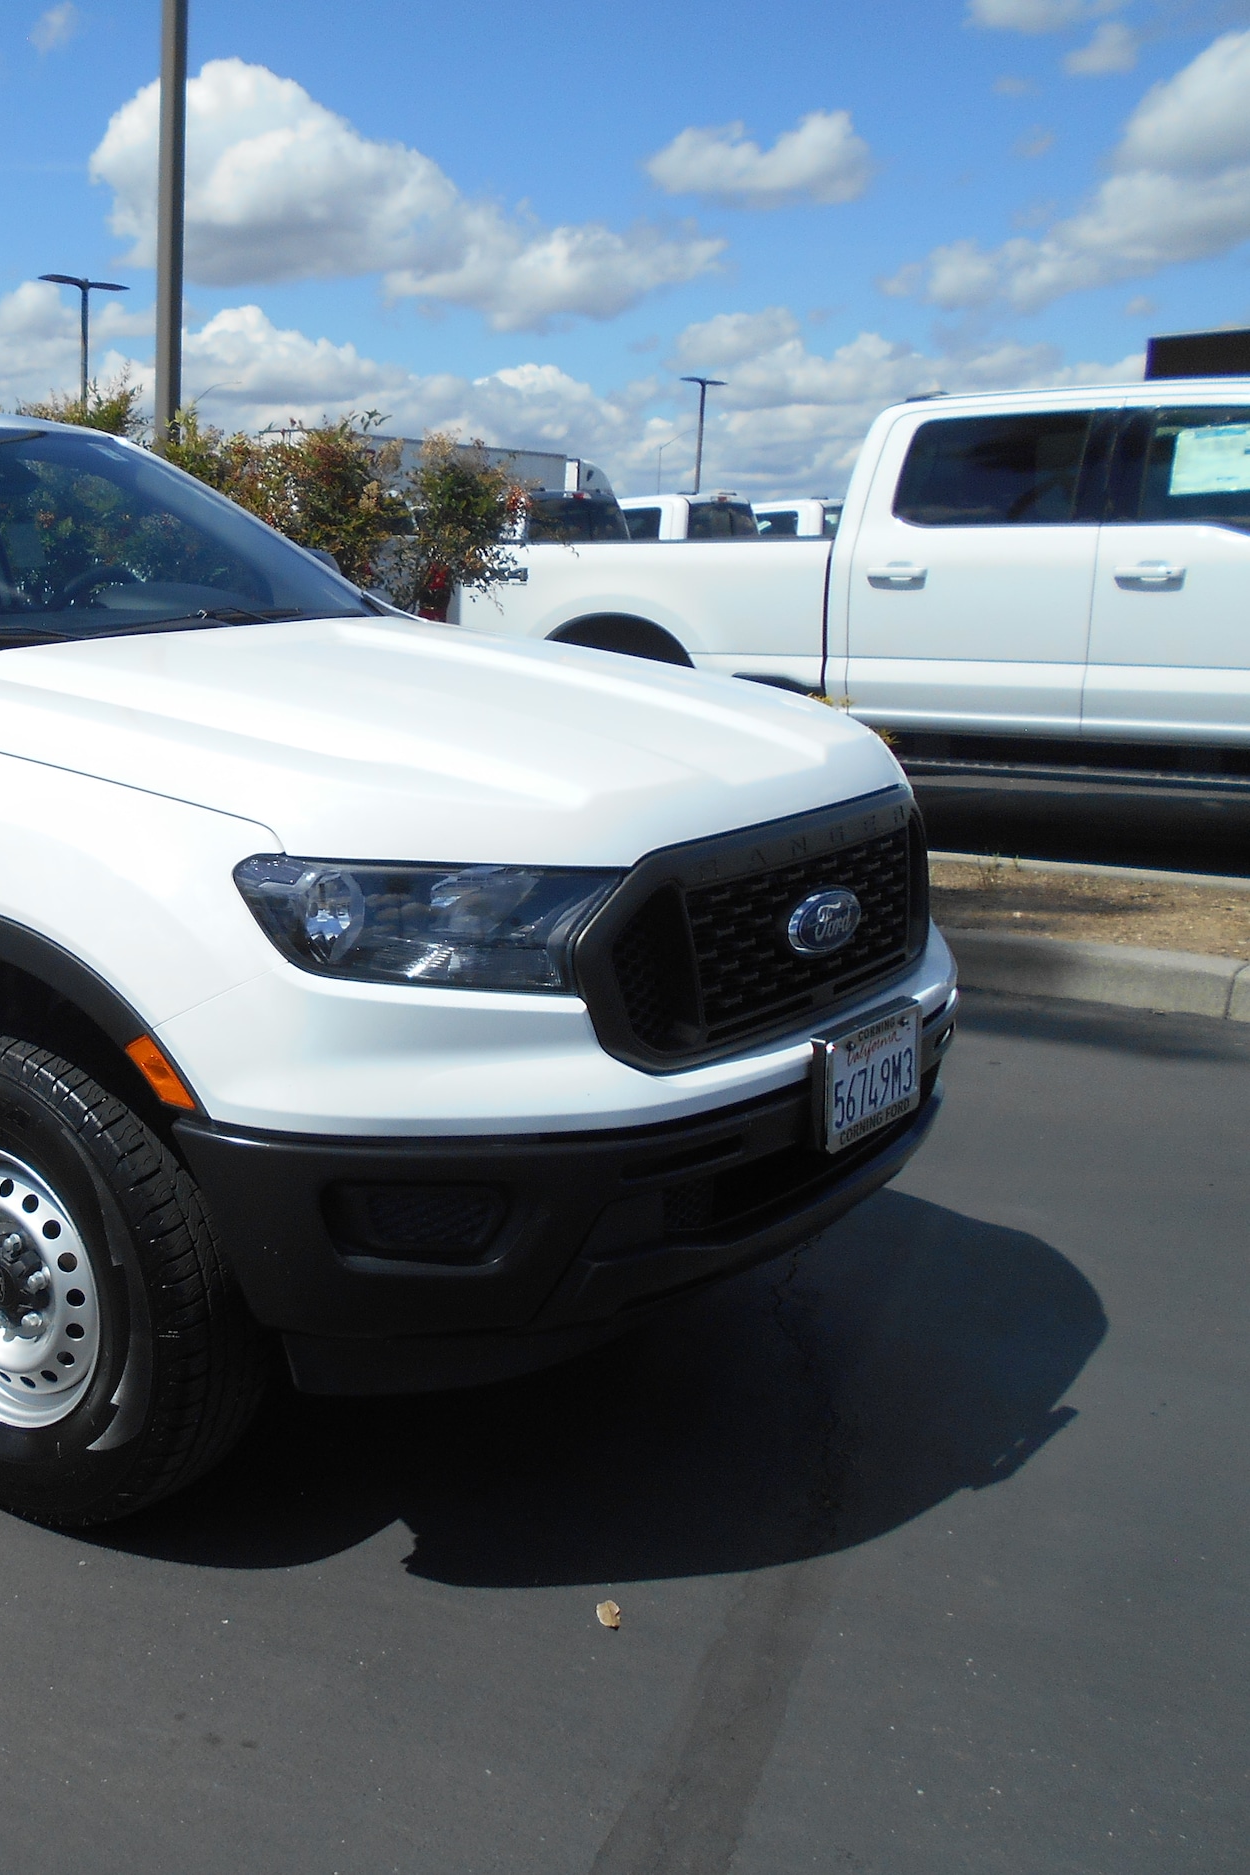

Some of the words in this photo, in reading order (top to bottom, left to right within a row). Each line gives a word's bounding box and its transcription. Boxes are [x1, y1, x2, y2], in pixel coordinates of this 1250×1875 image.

[811, 901, 852, 941] Ford
[847, 1030, 902, 1066] California
[857, 1016, 896, 1042] CORNING
[834, 1046, 913, 1129] 56749M3
[840, 1113, 883, 1145] CORNING
[885, 1097, 911, 1120] FORD
